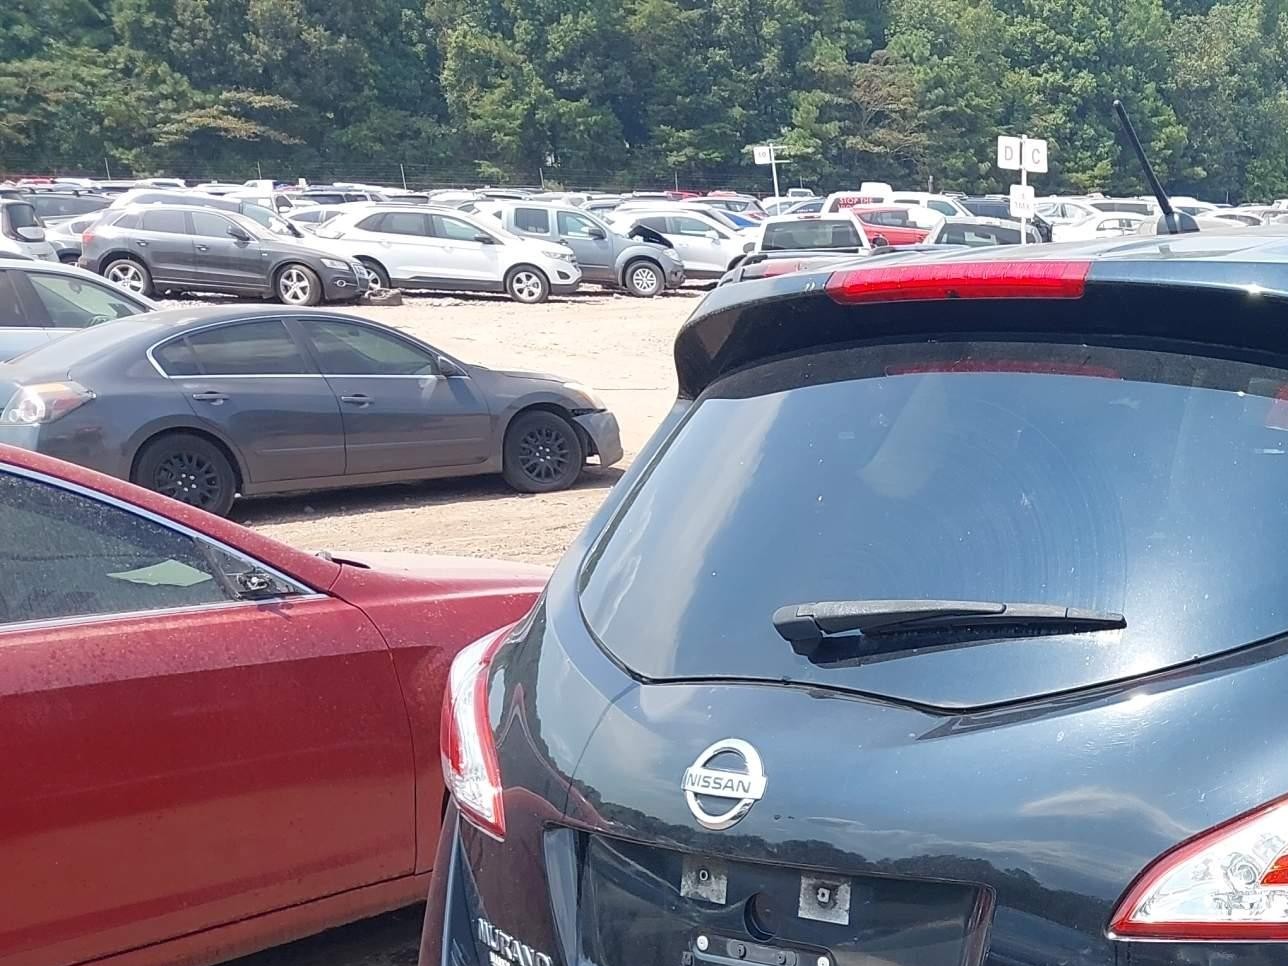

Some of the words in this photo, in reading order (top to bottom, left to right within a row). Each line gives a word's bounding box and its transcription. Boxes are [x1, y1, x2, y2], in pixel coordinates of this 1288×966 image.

[1004, 146, 1013, 161] D
[1032, 148, 1040, 164] C
[686, 773, 751, 793] NISSAN
